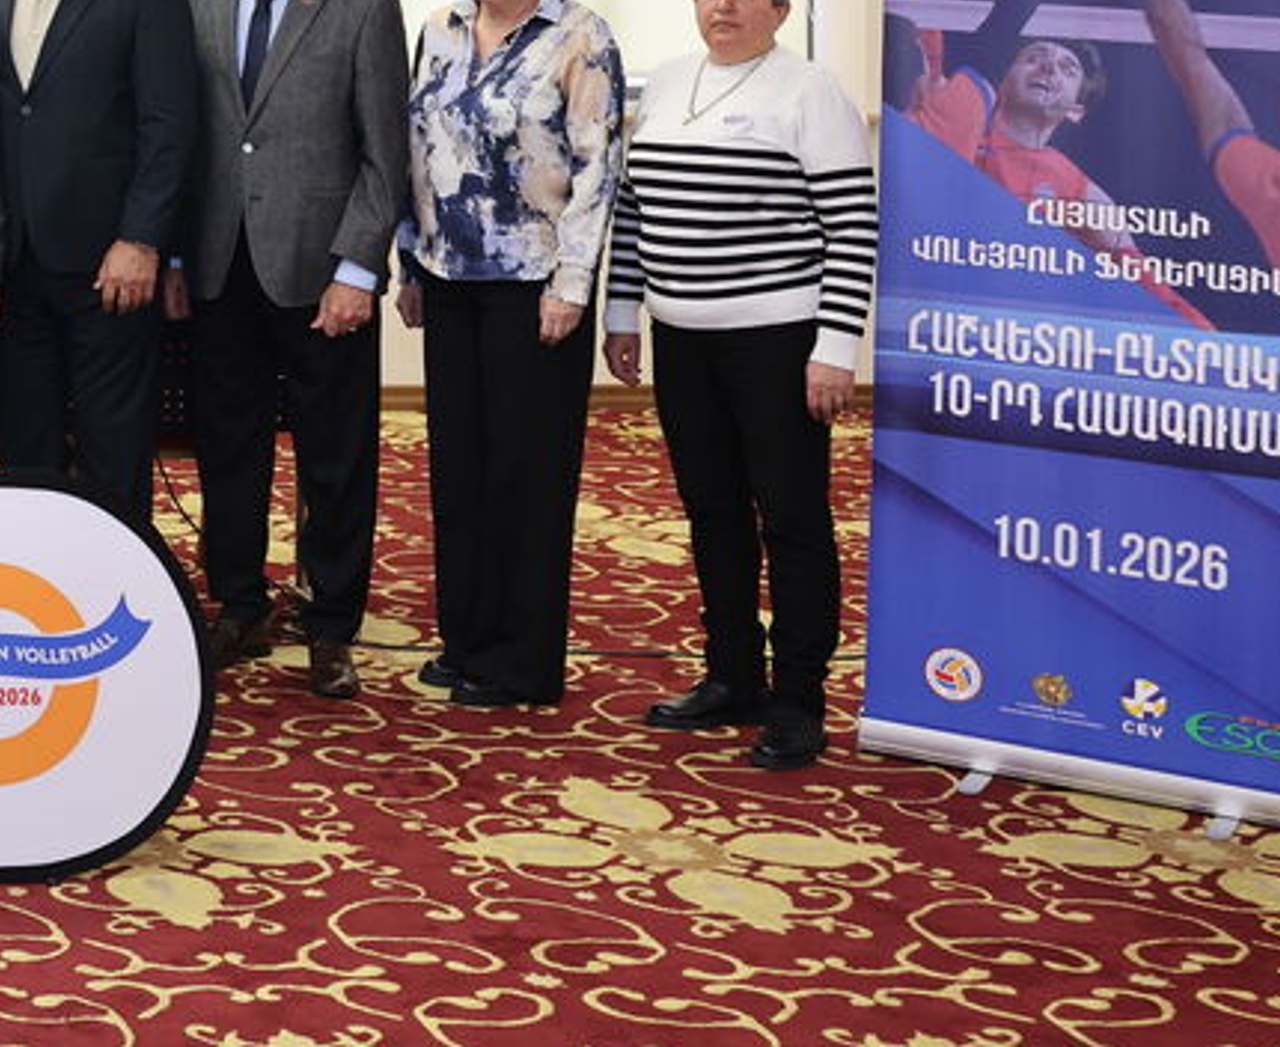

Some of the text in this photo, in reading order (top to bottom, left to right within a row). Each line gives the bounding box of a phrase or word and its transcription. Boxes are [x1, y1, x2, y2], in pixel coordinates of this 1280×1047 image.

[1027, 198, 1211, 240] ՀԱՅԱՍՏԱՆԻ
[912, 234, 1086, 276] ՎՈԼԵՅԲՈԼԻ
[928, 370, 1042, 427] 10-ՐԴ
[994, 514, 1229, 591] 10.01.2026
[13, 632, 119, 665] VOLLEYBALL
[1121, 720, 1164, 740] CEV
